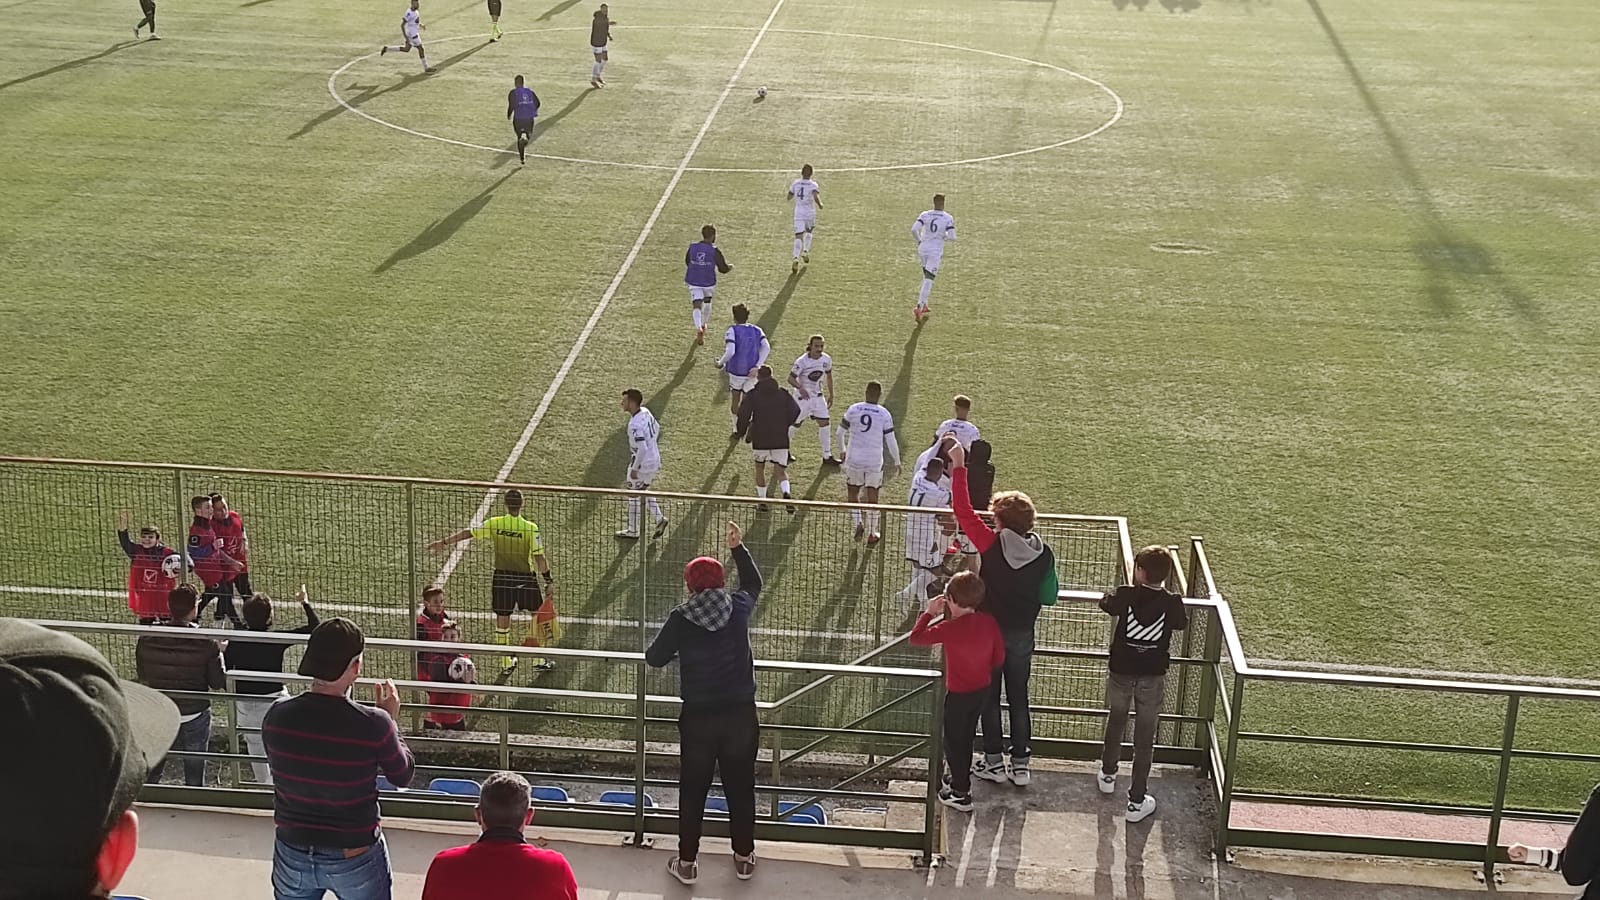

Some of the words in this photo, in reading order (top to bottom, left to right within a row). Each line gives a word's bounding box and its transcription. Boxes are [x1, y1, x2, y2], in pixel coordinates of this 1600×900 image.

[797, 187, 804, 200] 4
[930, 218, 938, 233] 6
[860, 414, 873, 433] 9
